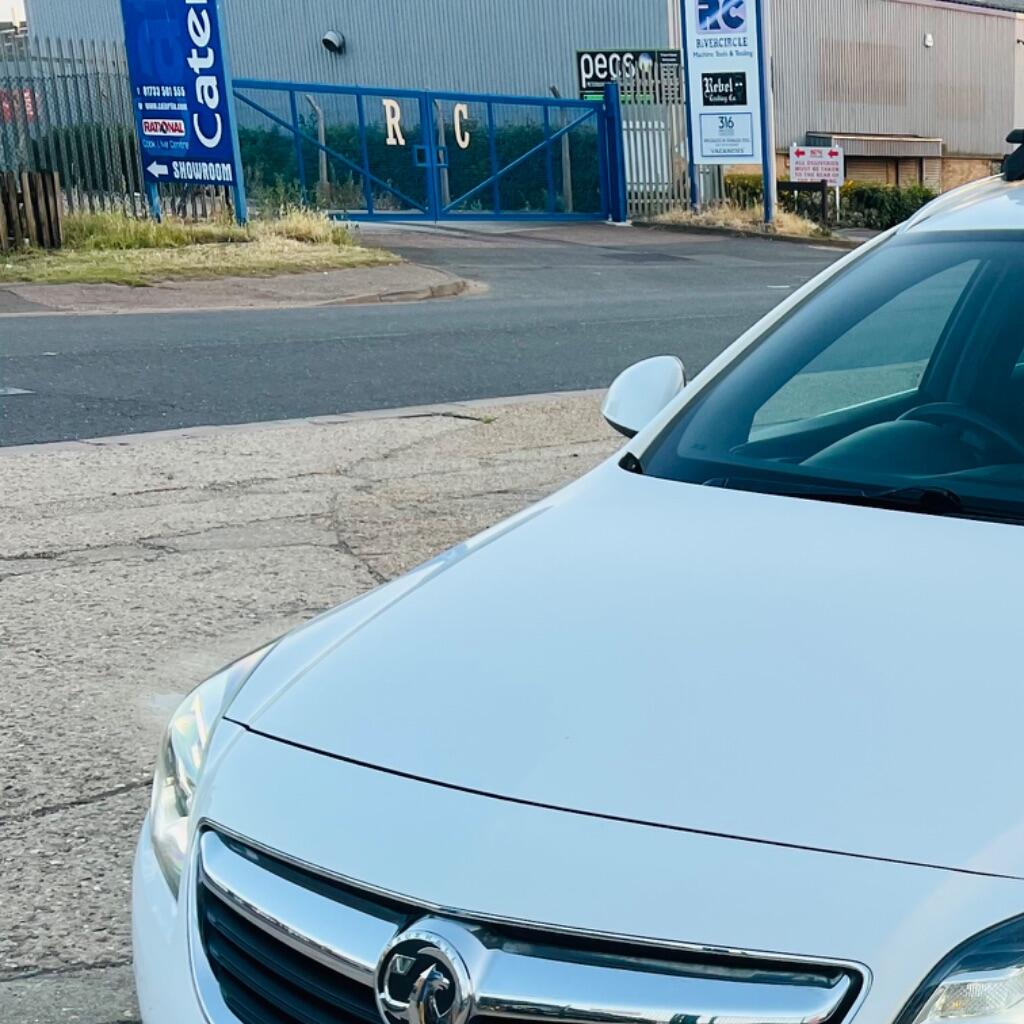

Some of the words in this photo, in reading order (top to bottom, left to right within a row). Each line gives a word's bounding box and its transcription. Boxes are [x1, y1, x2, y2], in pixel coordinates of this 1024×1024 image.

[185, 0, 222, 148] Cate
[703, 77, 733, 93] Rebel
[143, 121, 184, 134] RATIONAL
[382, 98, 405, 146] R
[454, 103, 470, 149] C
[718, 116, 734, 129] 316
[172, 161, 232, 181] SHOWROOM
